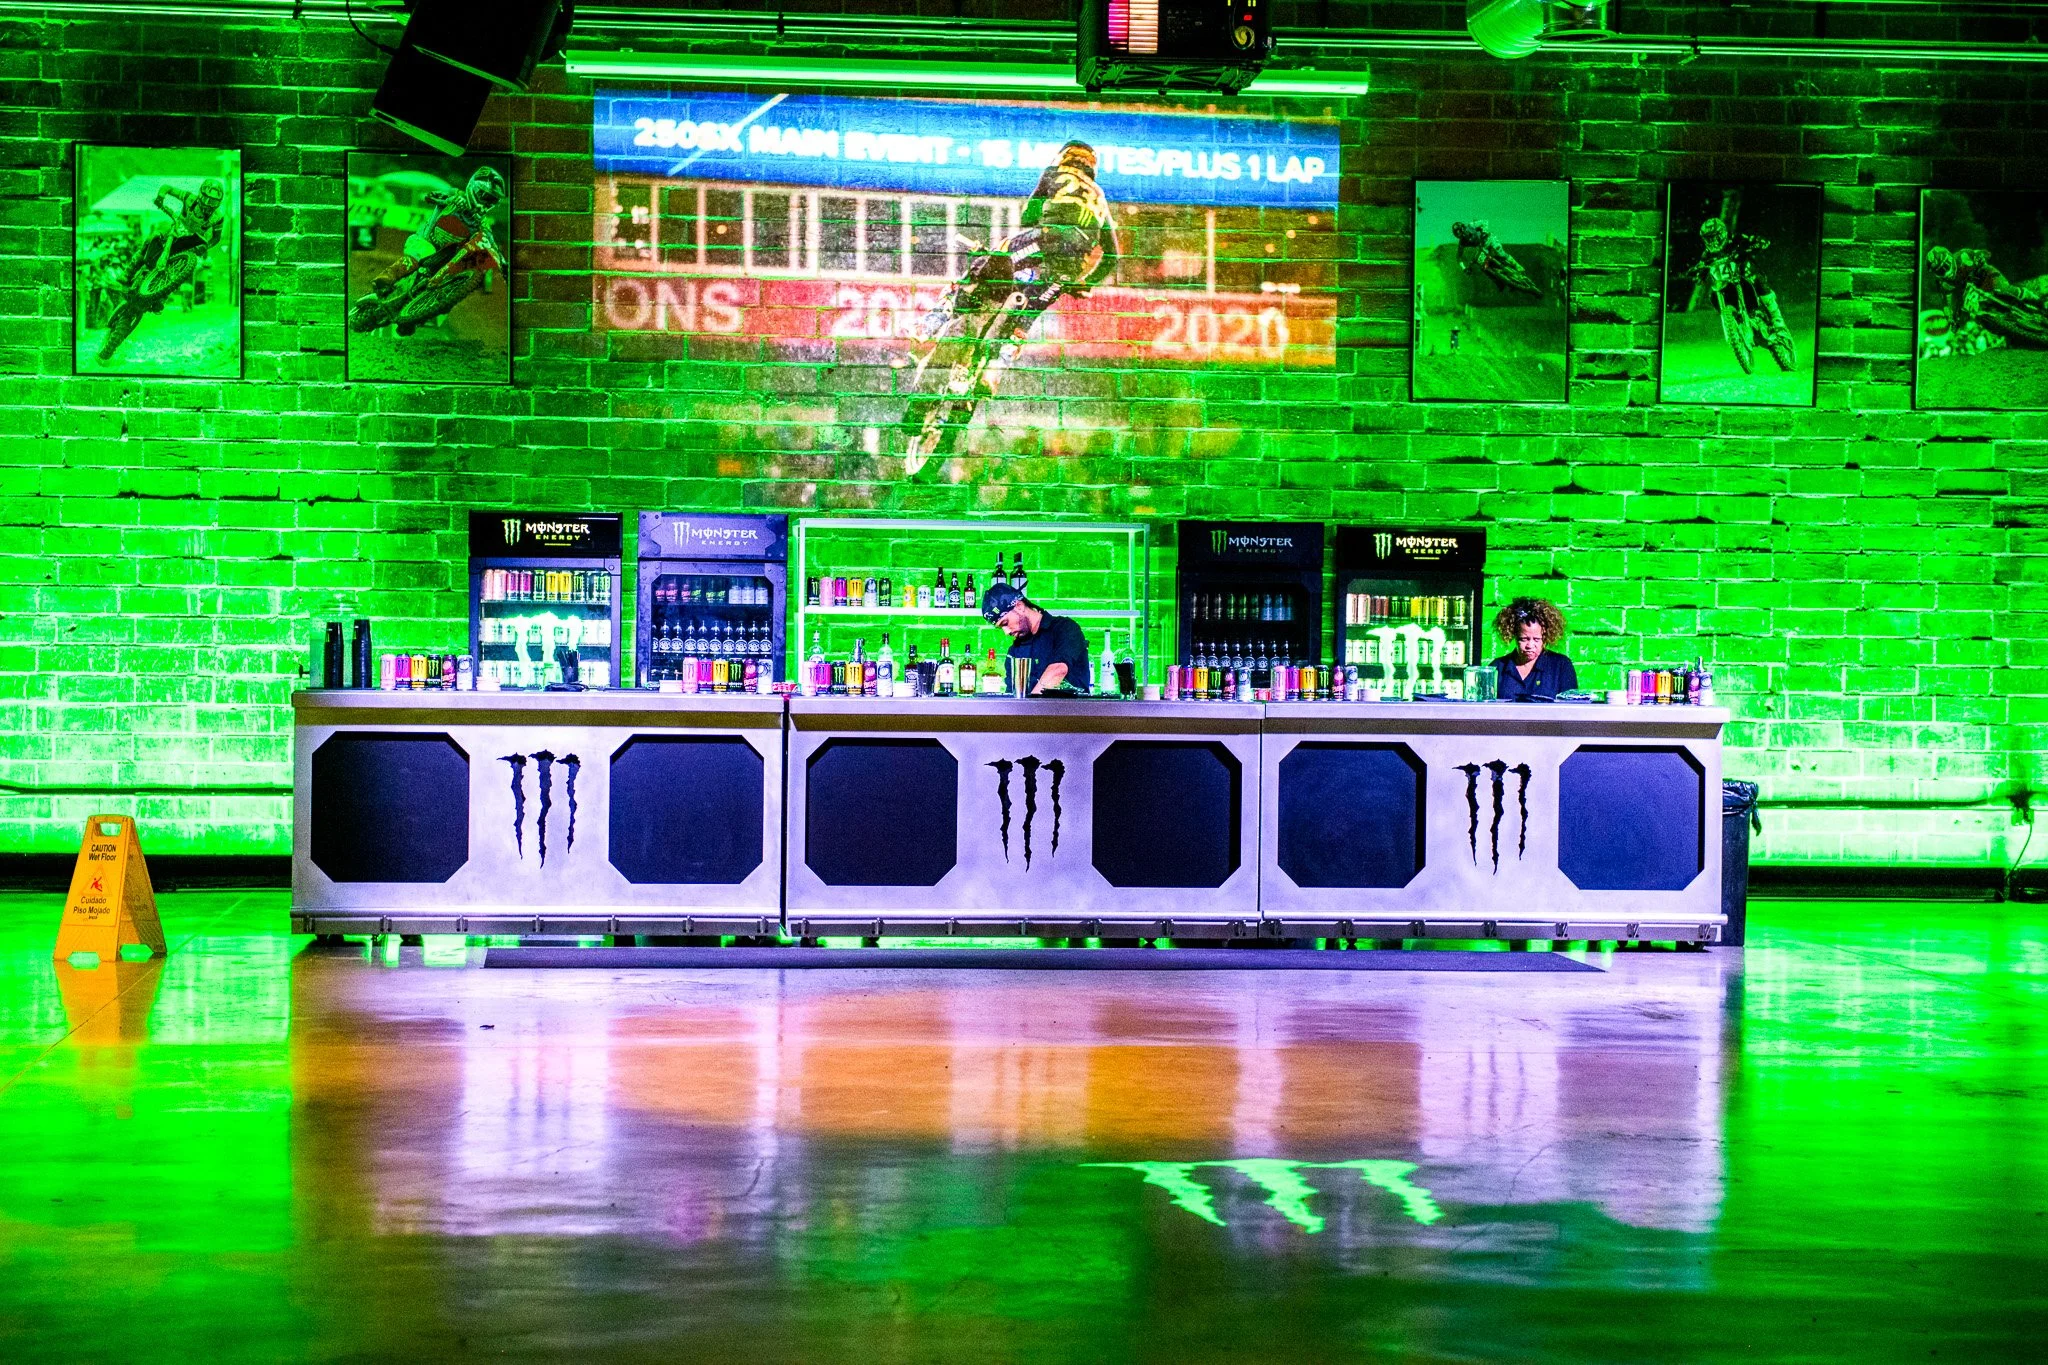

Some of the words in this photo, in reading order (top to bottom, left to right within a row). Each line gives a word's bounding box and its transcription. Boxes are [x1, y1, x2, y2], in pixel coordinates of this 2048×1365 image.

[749, 125, 839, 159] MAIN
[845, 132, 954, 165] EVENT
[979, 140, 1012, 168] 15
[1246, 156, 1261, 182] 1
[1267, 157, 1325, 184] LAP
[604, 278, 743, 333] ONS
[1150, 306, 1290, 358] 2020
[525, 521, 591, 535] MONSTER
[691, 527, 759, 540] MONSTER
[1228, 535, 1294, 548] MONSTER
[1395, 535, 1459, 549] MONSTER
[91, 844, 117, 852] CAUTION
[88, 853, 100, 861] Wet
[101, 853, 117, 861] Floor
[80, 896, 107, 904] Cuidado
[73, 906, 87, 914] Piso
[88, 906, 111, 916] Mojado
